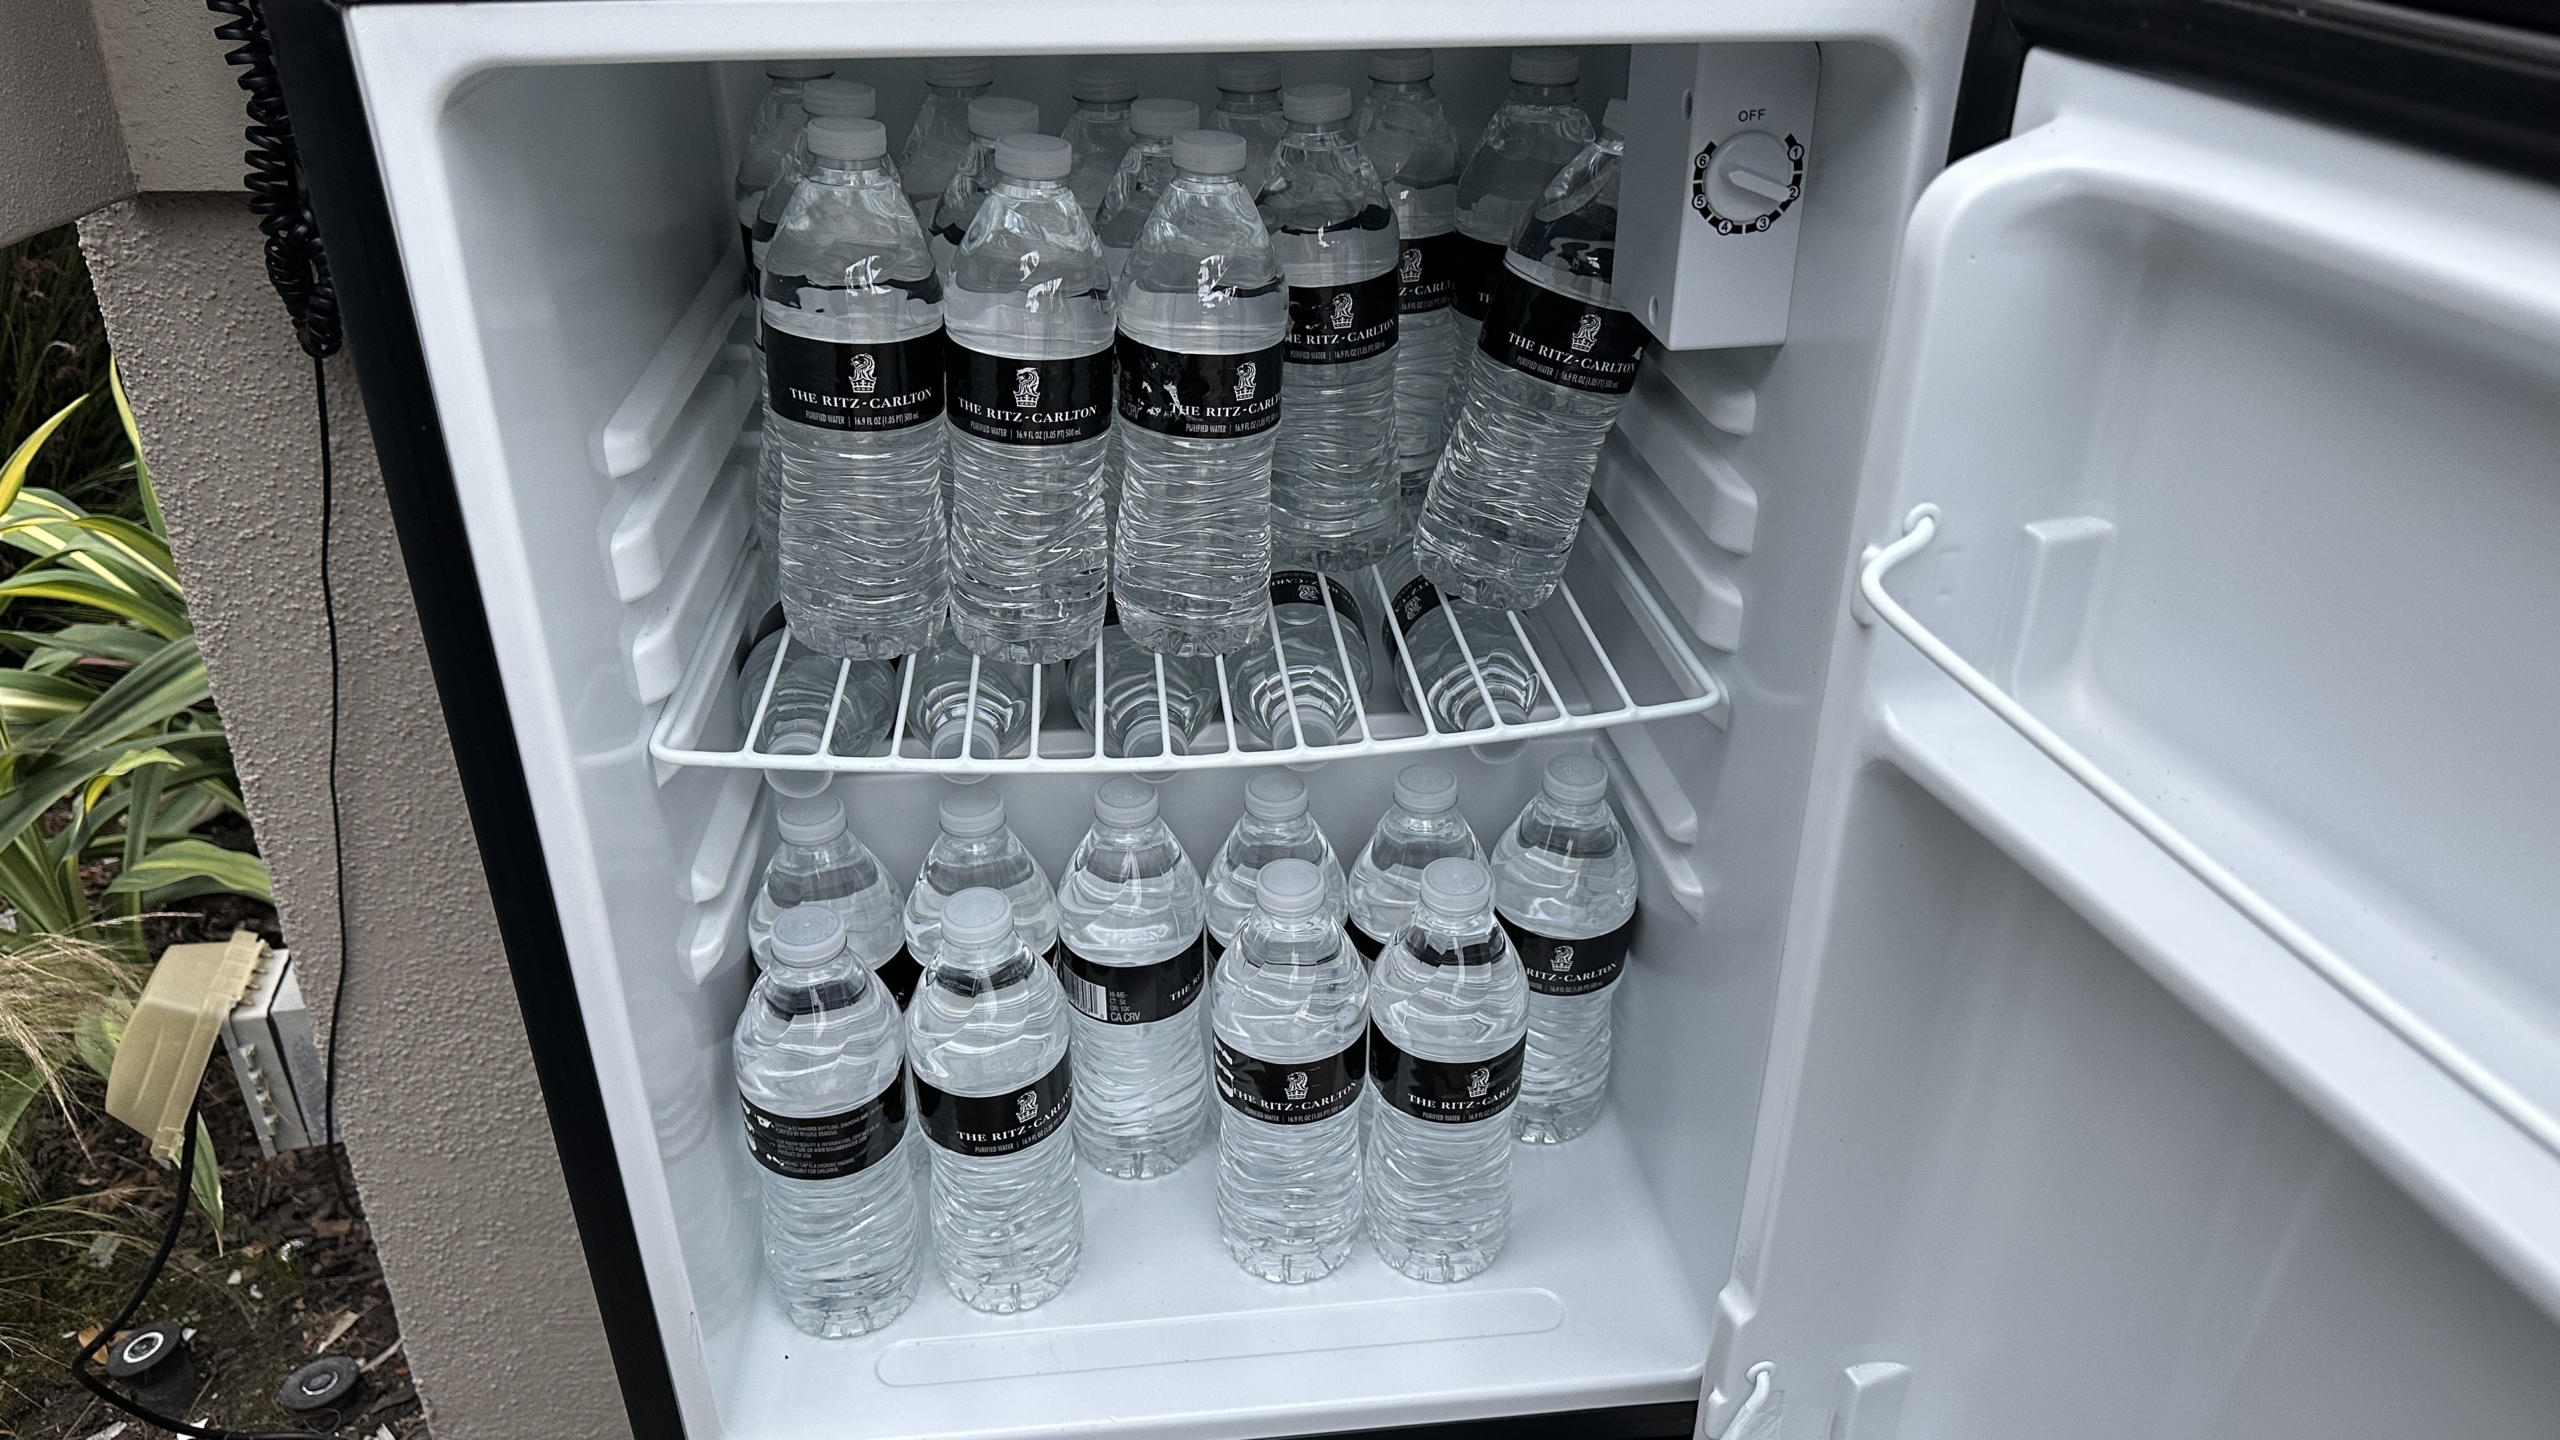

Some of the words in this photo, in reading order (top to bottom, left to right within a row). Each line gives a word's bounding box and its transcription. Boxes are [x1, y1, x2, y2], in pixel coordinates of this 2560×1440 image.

[1737, 109, 1766, 122] OFF
[1508, 331, 1535, 352] THE
[1538, 344, 1637, 374] RITZ-CARLTON
[1516, 355, 1536, 371] PURIFIED
[1537, 363, 1553, 376] WATER
[1560, 370, 1572, 381] 16.9
[1572, 373, 1578, 383] FL
[1578, 374, 1585, 385] OZ
[789, 387, 817, 404] THE
[822, 387, 932, 409] RITZ-CARLTON
[958, 397, 982, 416] THE
[986, 405, 1097, 424] RITZ-CARLTON
[1169, 402, 1200, 417] THE
[805, 410, 826, 422] PURIFIED
[828, 414, 845, 425] WATER
[854, 417, 866, 426] 16.9
[867, 417, 873, 426] FL
[873, 416, 881, 425] OZ
[970, 420, 990, 434] PURIFIED
[991, 427, 1007, 438] WATER
[1016, 430, 1027, 439] 16.9
[1028, 430, 1035, 439] FL
[1035, 430, 1043, 440] OZ
[1065, 428, 1074, 437] 500
[1186, 423, 1209, 433] PURIFIED
[1209, 424, 1226, 433] WATER
[1169, 983, 1191, 1002] THE
[1110, 1012, 1122, 1022] CA
[1123, 1011, 1141, 1023] CRV
[1233, 1087, 1256, 1104] THE
[1260, 1081, 1357, 1111] RITZ-CARLTON
[1407, 1093, 1436, 1108] THE
[1304, 1112, 1312, 1122] OZ
[1422, 1111, 1444, 1121] PURIFIED
[1444, 1114, 1460, 1122] WATER
[956, 1130, 987, 1142] THE
[974, 1144, 997, 1153] PURIFIED
[998, 1142, 1014, 1152] WATER
